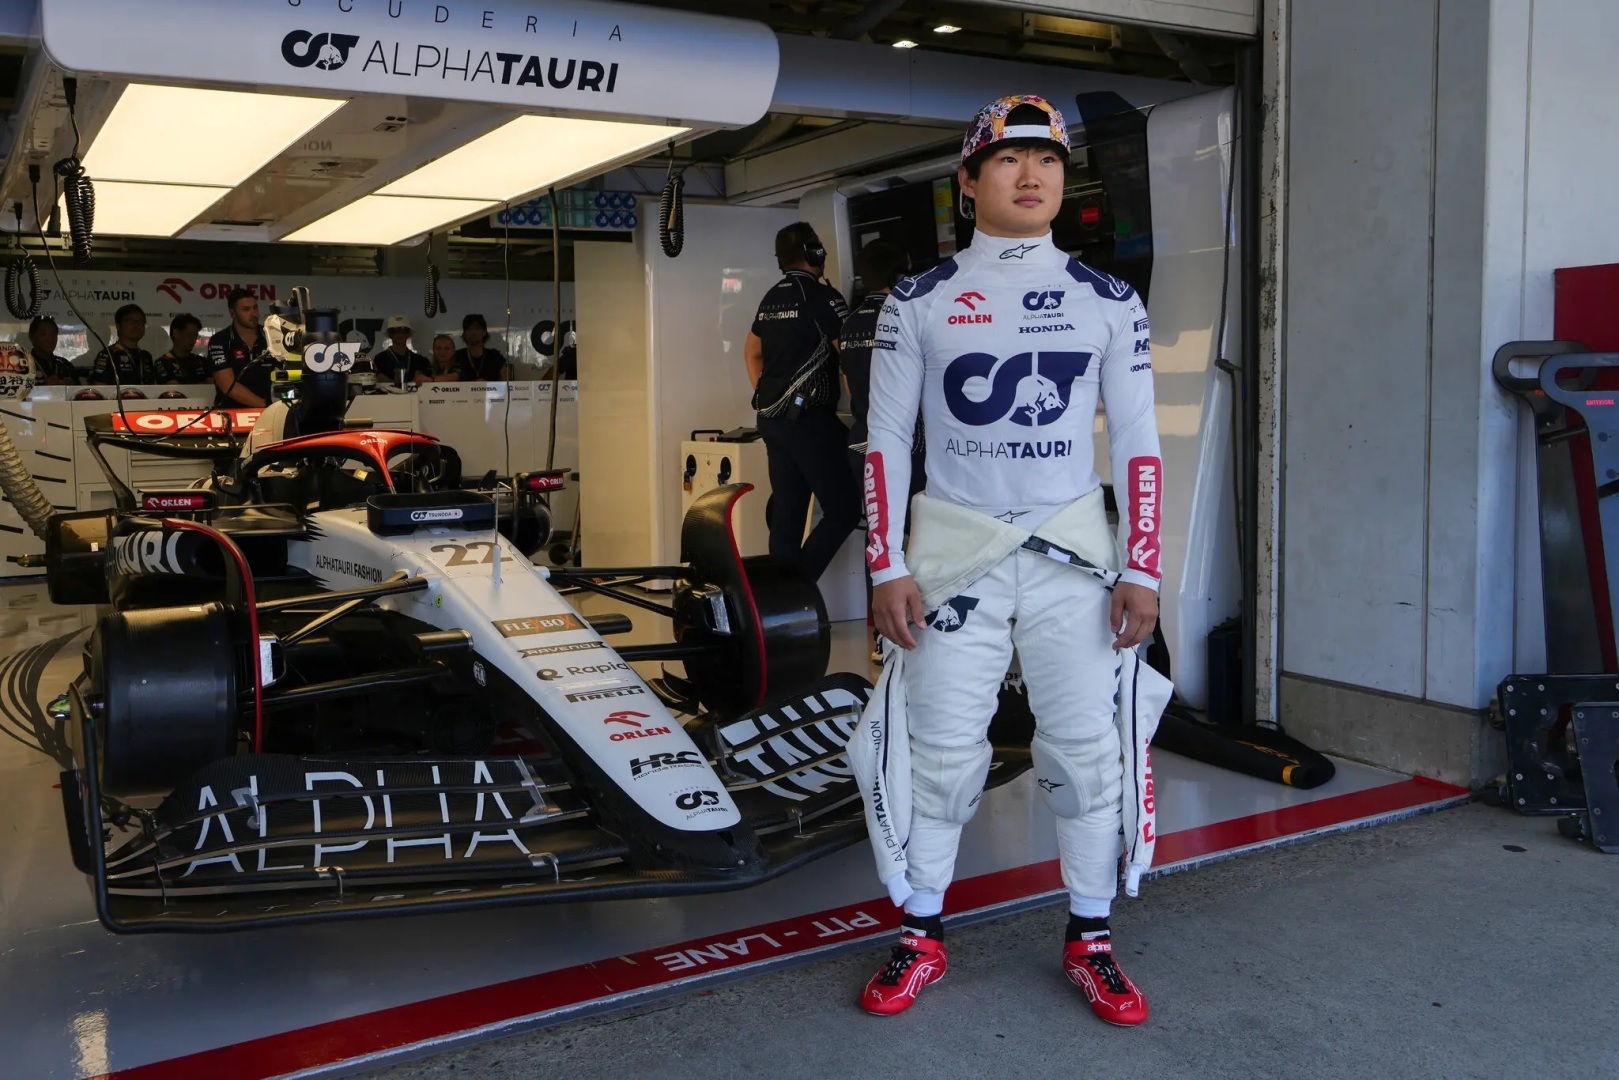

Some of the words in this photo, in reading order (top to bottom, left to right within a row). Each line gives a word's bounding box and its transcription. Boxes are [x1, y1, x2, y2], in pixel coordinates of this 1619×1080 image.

[362, 40, 619, 93] ALPHATAURI
[947, 314, 992, 325] ORLEN
[1023, 312, 1064, 320] ALPHATAURI
[1019, 323, 1075, 334] HONDA
[136, 412, 259, 430] ORLE
[945, 437, 1072, 459] ALPHATAURI
[161, 498, 191, 506] ORLEN
[865, 462, 880, 527] ORLEN
[1138, 465, 1155, 532] ORLEN
[431, 541, 513, 567] 22
[525, 642, 602, 656] RAVENOL
[565, 685, 645, 703] PIRELLI
[609, 726, 672, 742] ORLEN
[630, 751, 702, 777] HRC
[180, 760, 531, 878] ALPHA
[811, 911, 881, 938] PIT
[654, 932, 782, 972] LANE
